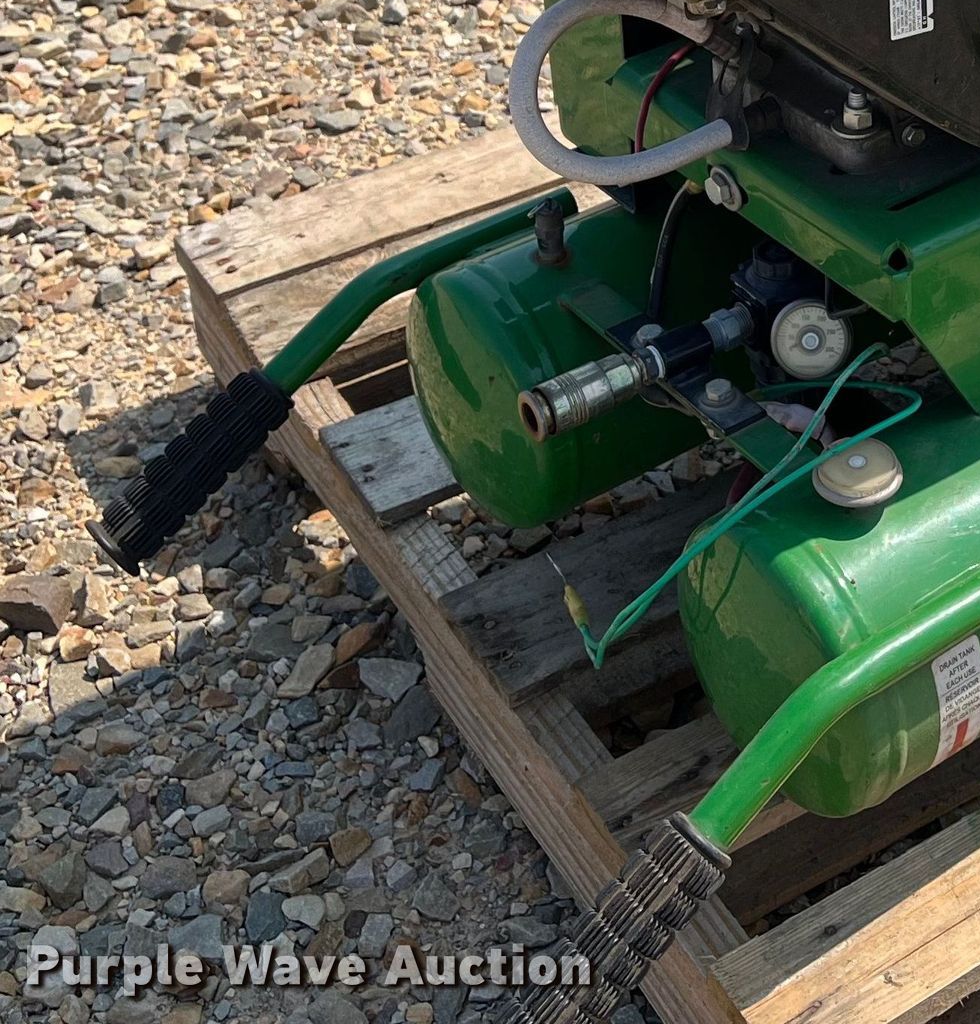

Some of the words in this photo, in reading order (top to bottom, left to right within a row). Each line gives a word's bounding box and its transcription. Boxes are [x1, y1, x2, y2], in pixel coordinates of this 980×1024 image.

[939, 656, 958, 672] DRAIN
[958, 645, 975, 659] TANK
[949, 660, 969, 678] AFTER
[946, 673, 963, 690] EACH
[964, 666, 977, 677] USE
[945, 704, 954, 713] DE
[955, 686, 980, 707] VIDANGE
